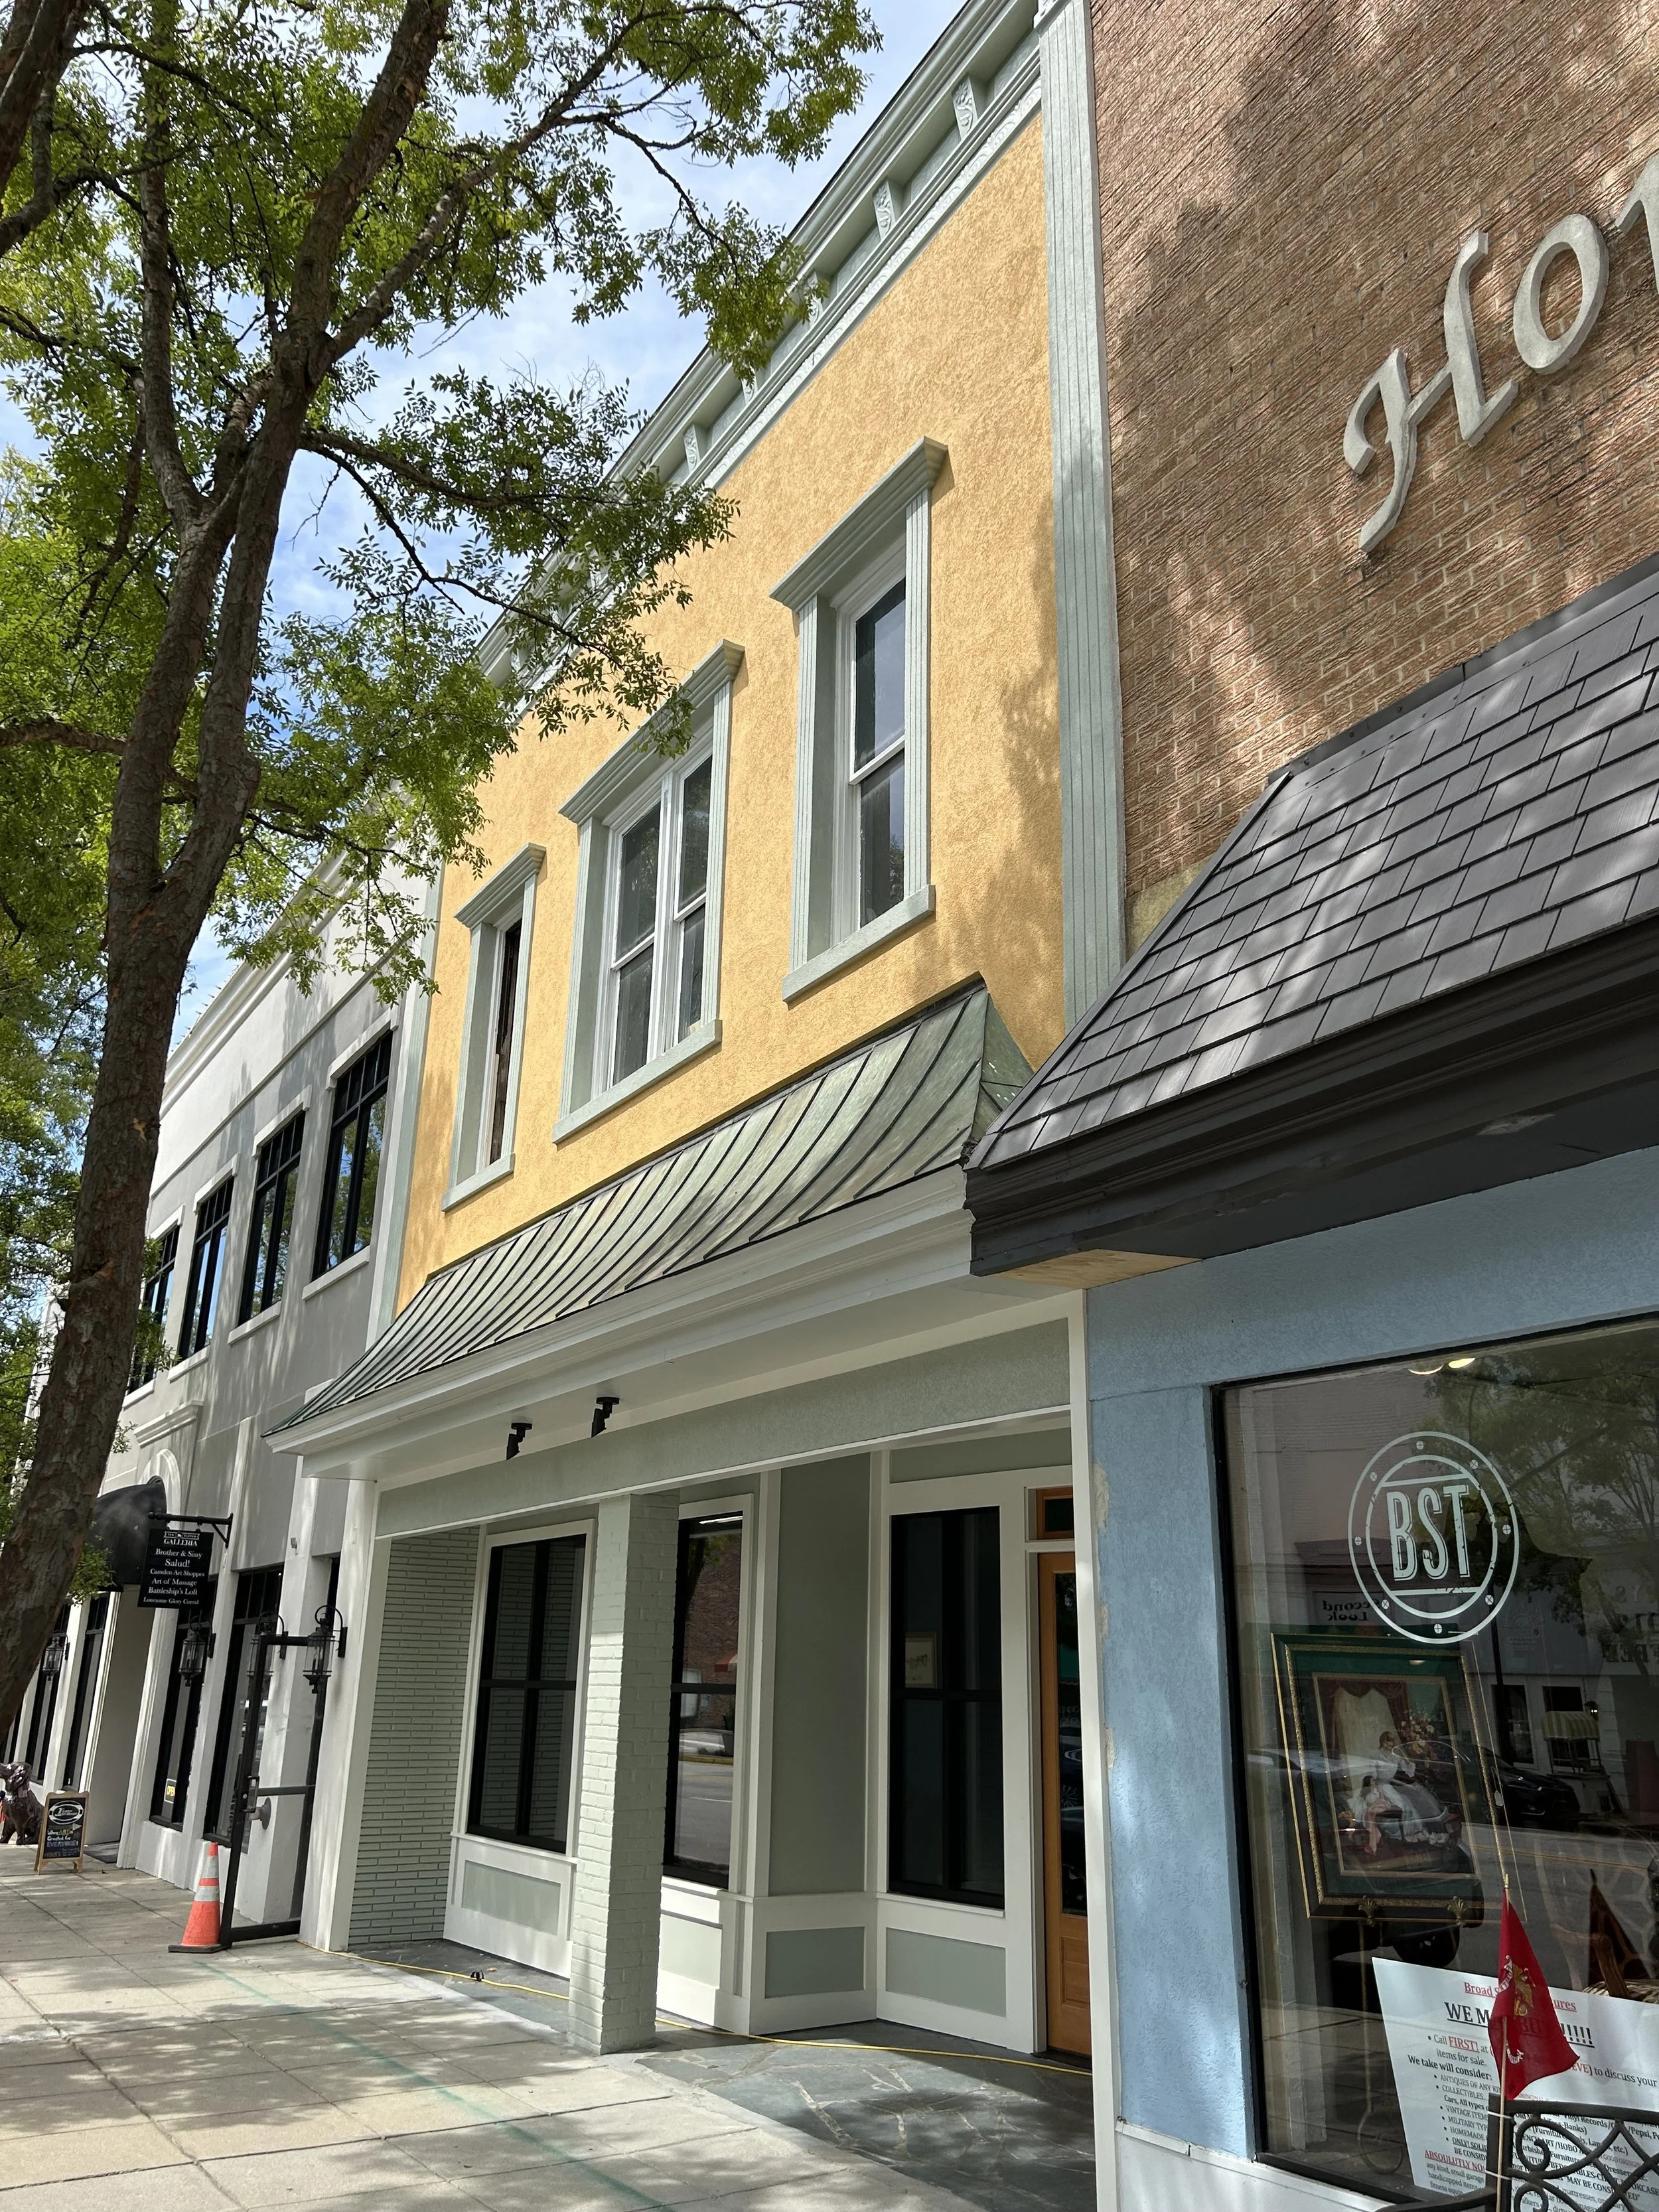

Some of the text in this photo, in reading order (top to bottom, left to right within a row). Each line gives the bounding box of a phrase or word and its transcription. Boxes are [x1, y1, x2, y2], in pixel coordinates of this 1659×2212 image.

[1386, 1485, 1471, 1581] BST
[187, 1550, 202, 1559] Sissy
[165, 1558, 190, 1567] Salud!
[183, 1570, 204, 1578] Shoppes
[172, 1578, 197, 1587] Massage
[148, 1586, 183, 1595] Battleship's
[1463, 1982, 1492, 1996] Broad
[1444, 2002, 1473, 2023] WE
[1433, 2034, 1447, 2045] Call
[1448, 2036, 1479, 2052] FIRST!
[1480, 2045, 1488, 2053] at
[1595, 2067, 1603, 2076] to
[1605, 2068, 1636, 2083] discuss
[1637, 2076, 1658, 2088] your
[1437, 2049, 1486, 2067] items for sale.
[1407, 2055, 1492, 2080] We take will consider:
[1441, 2075, 1469, 2087] ANTIQUES
[1446, 2105, 1471, 2117] VINTAGE
[1448, 2116, 1475, 2128] MILITARY
[1450, 2126, 1485, 2140] HOMEMADE
[1452, 2137, 1470, 2148] ONLY!
[1426, 2162, 1436, 2171] any
[1451, 2168, 1465, 2177] small
[1427, 2171, 1463, 2187] handicapped
